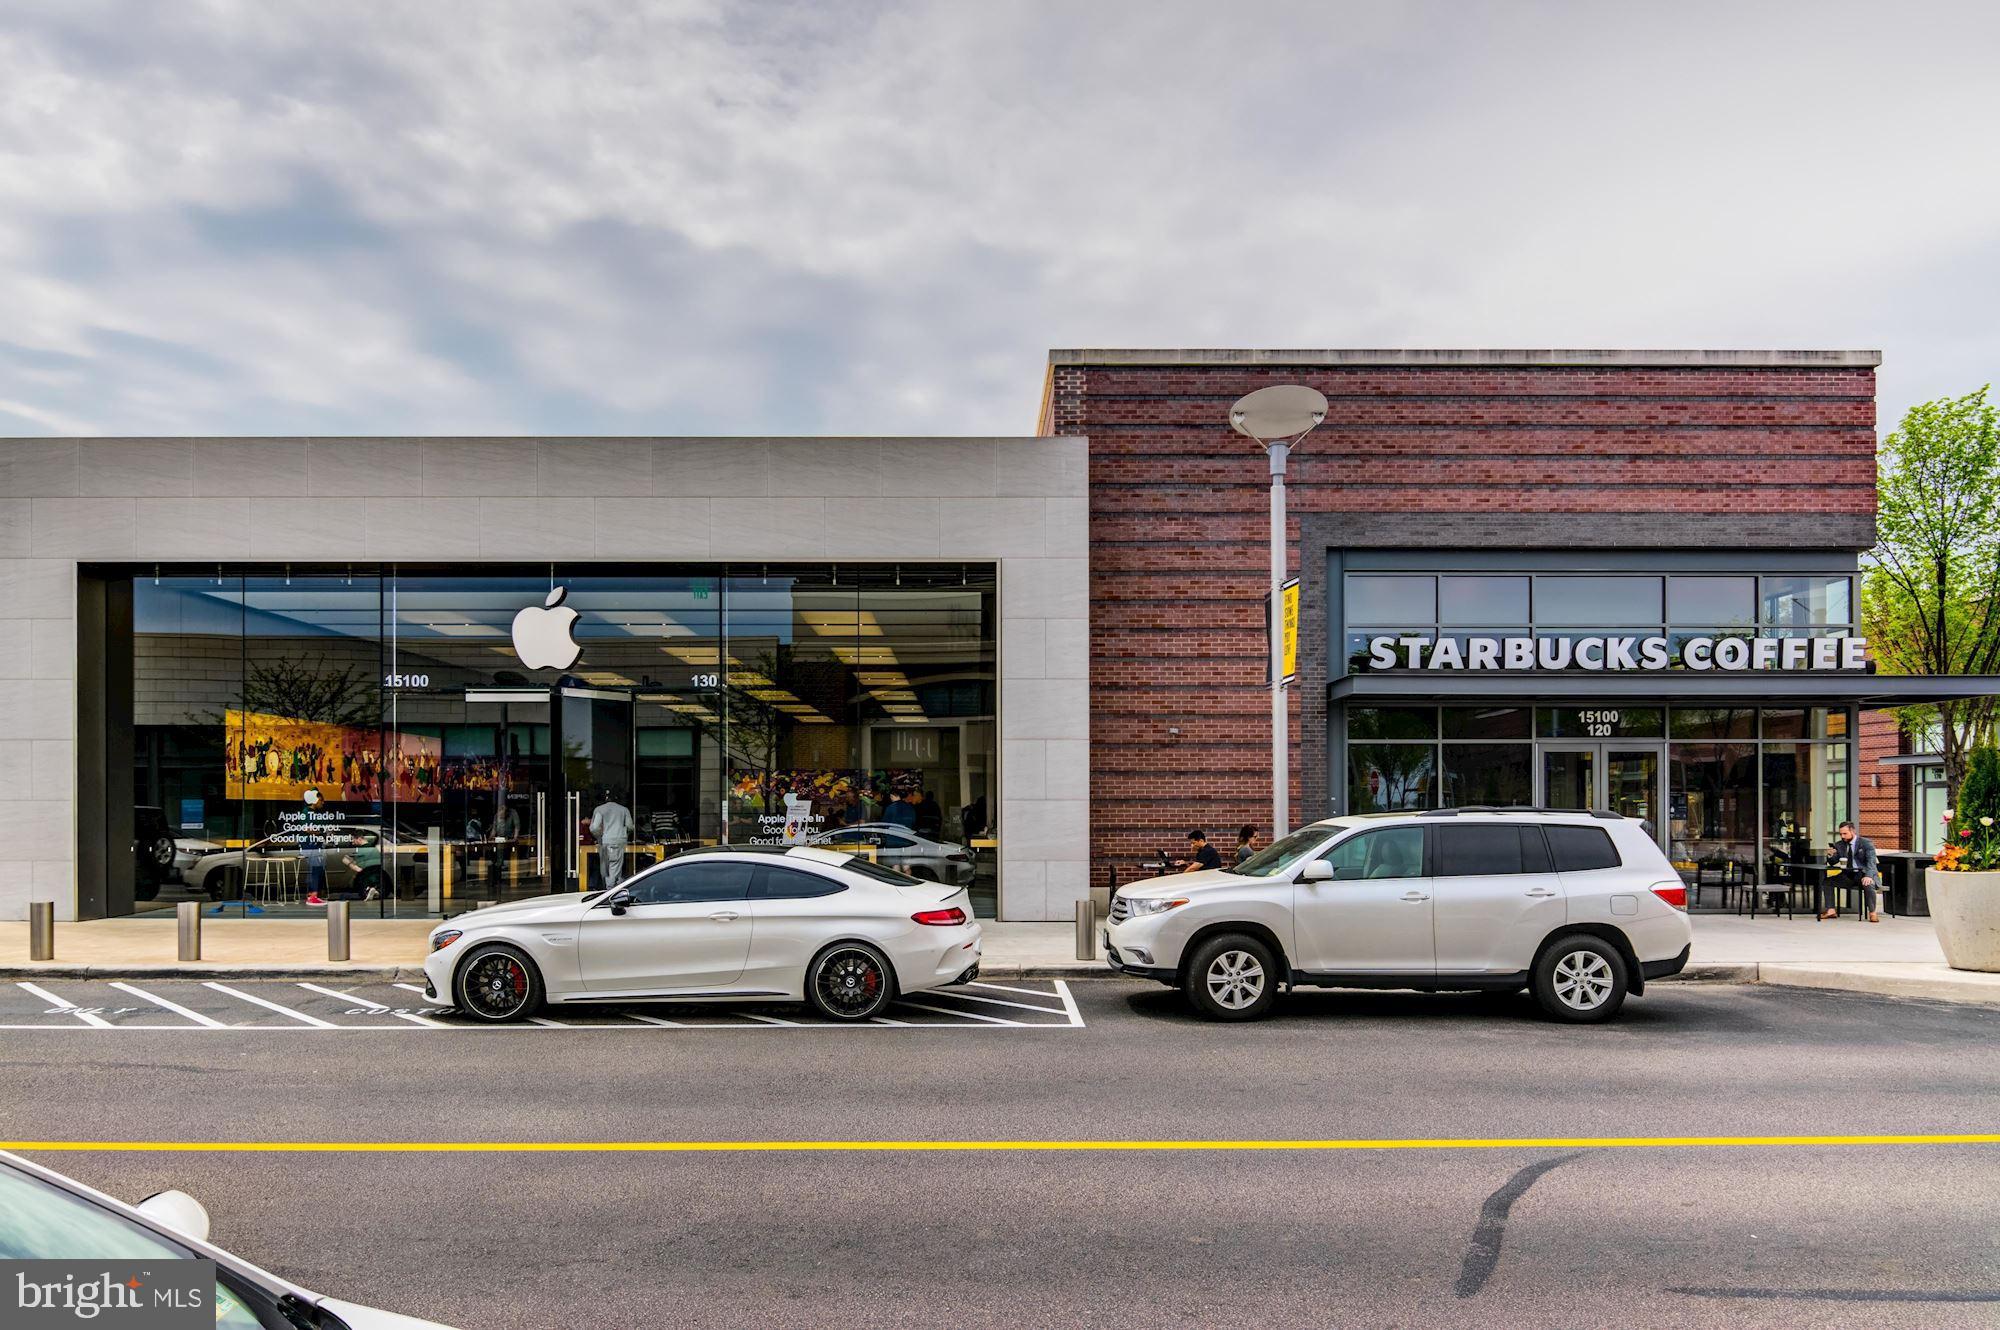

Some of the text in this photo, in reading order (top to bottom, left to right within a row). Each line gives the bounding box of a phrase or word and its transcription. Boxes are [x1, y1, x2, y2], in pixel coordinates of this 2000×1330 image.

[1369, 636, 1867, 670] STARBUCKS COFFEE
[385, 674, 429, 687] 15100
[691, 674, 718, 687] 130
[1578, 710, 1619, 723] 15100
[1587, 723, 1612, 736] 120
[278, 811, 346, 822] Apple Trade In
[757, 814, 786, 825] Apple
[815, 813, 825, 823] In
[283, 822, 308, 831] Good
[308, 822, 321, 831] for
[762, 825, 788, 834] Good
[269, 834, 295, 843] Good
[296, 834, 308, 843] for
[309, 834, 325, 843] the
[749, 837, 775, 845] Good
